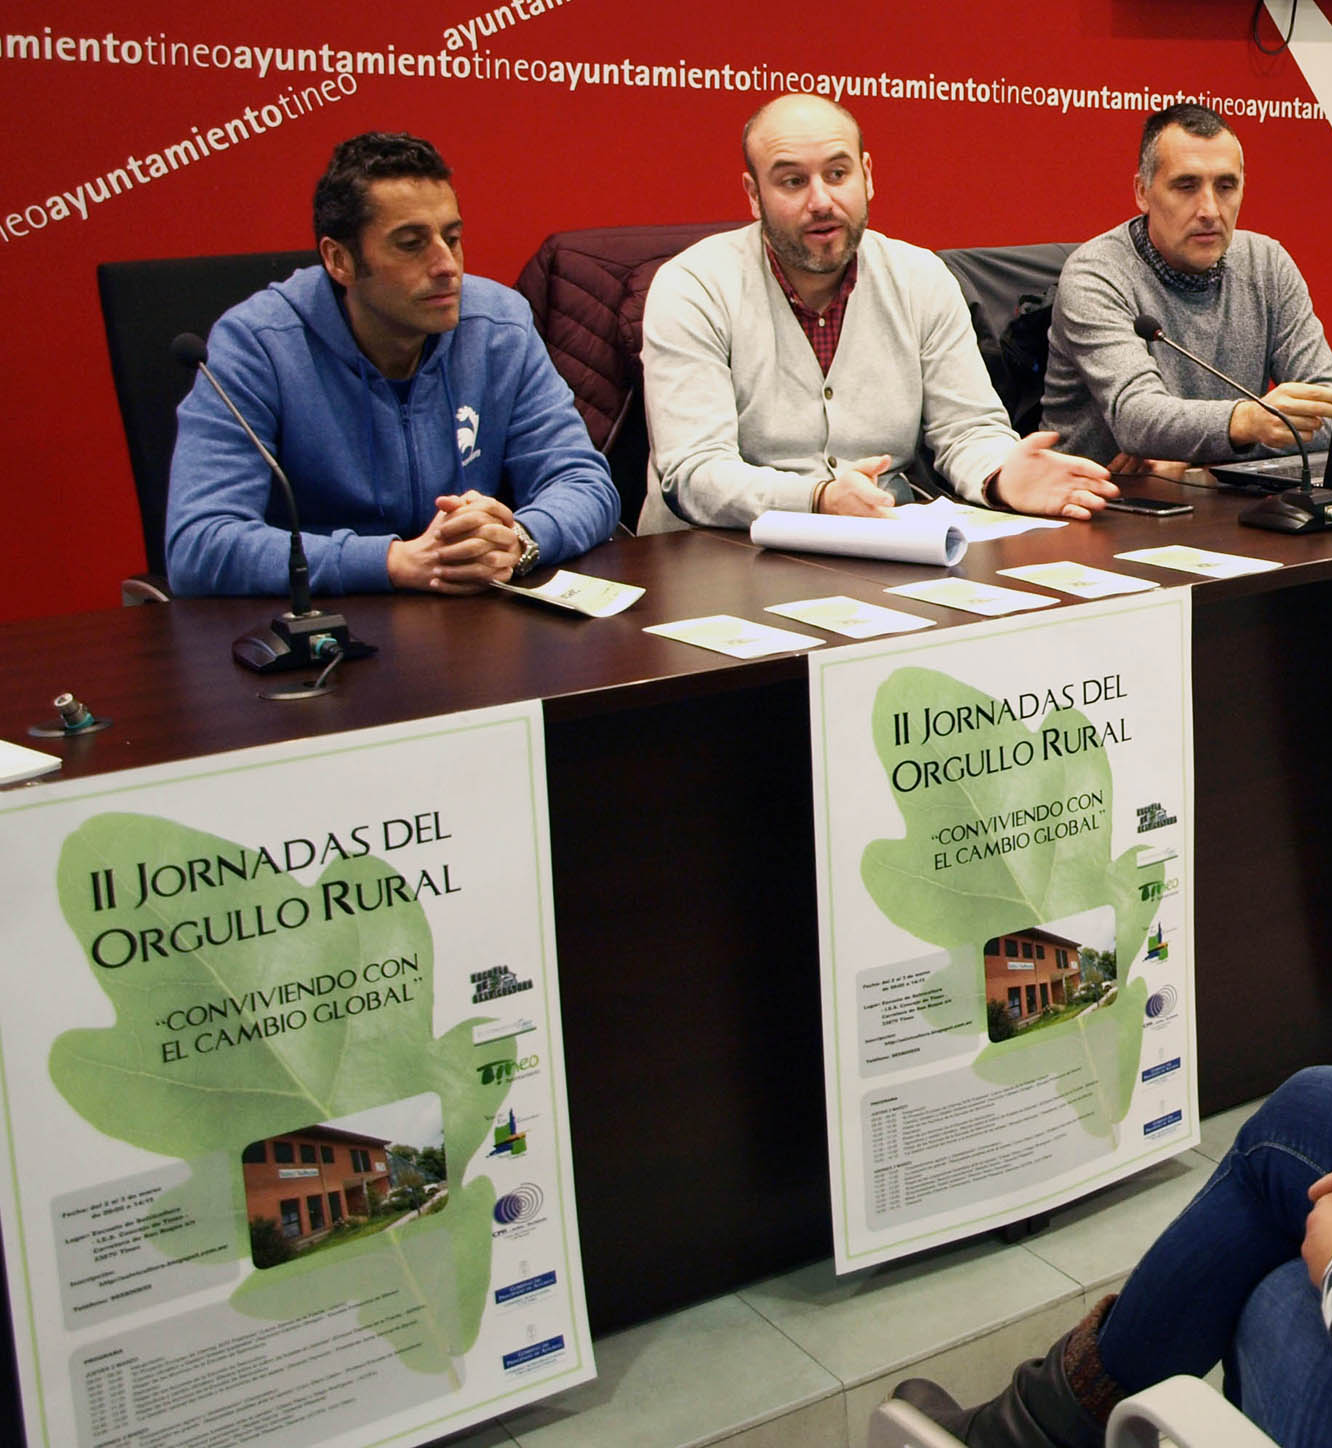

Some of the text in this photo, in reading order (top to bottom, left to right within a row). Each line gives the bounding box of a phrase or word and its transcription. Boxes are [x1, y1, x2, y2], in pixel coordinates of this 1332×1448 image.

[894, 674, 1128, 745] II JORNADAS DEL
[892, 718, 1132, 793] ORGULLO RURAL
[1067, 790, 1103, 813] CON
[90, 811, 452, 912] II JORNADAS DEL
[934, 852, 952, 870] EL
[956, 832, 1030, 865] CAMBIO
[91, 864, 462, 969] ORGULLO RURAL
[363, 953, 419, 983] CON
[161, 1040, 189, 1063] EL
[194, 1009, 307, 1054] CAMBIO
